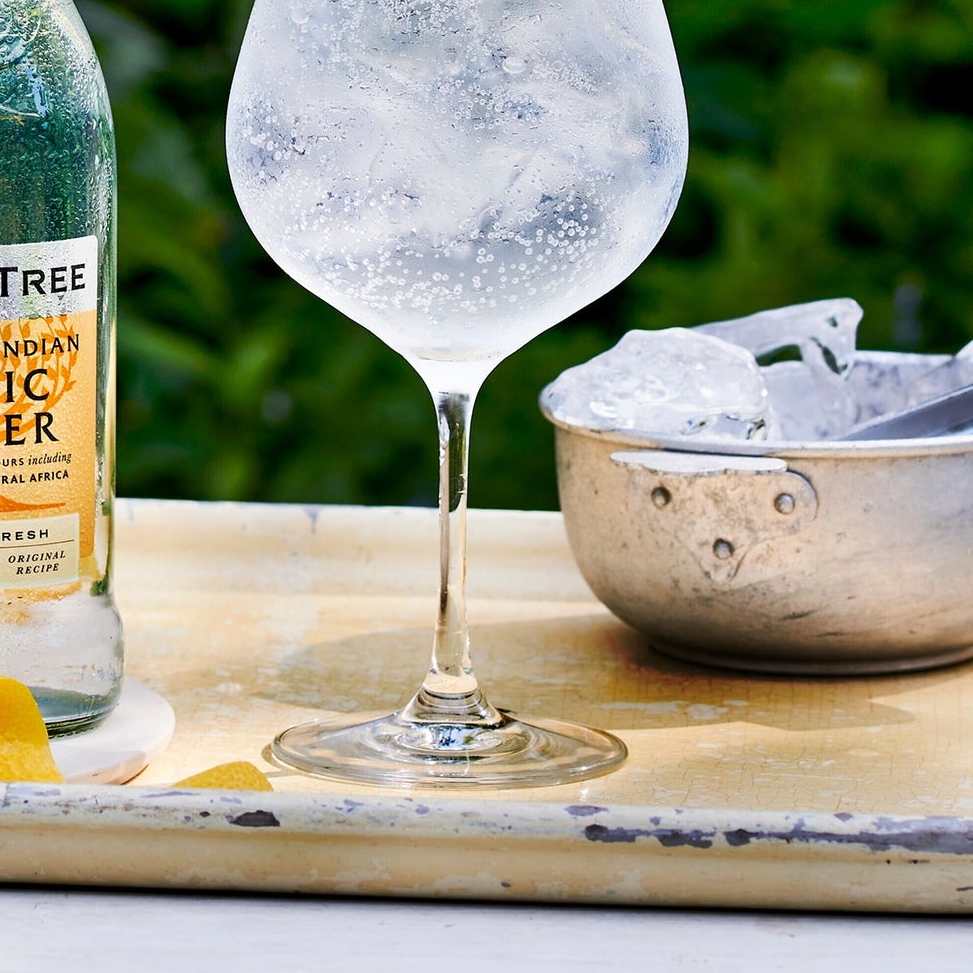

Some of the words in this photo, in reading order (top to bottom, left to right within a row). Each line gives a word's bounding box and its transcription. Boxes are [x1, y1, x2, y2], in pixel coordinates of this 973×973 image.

[27, 451, 72, 466] including
[29, 470, 70, 483] AFRICA
[8, 550, 66, 564] ORIGINAL
[15, 562, 60, 575] RECIPE
